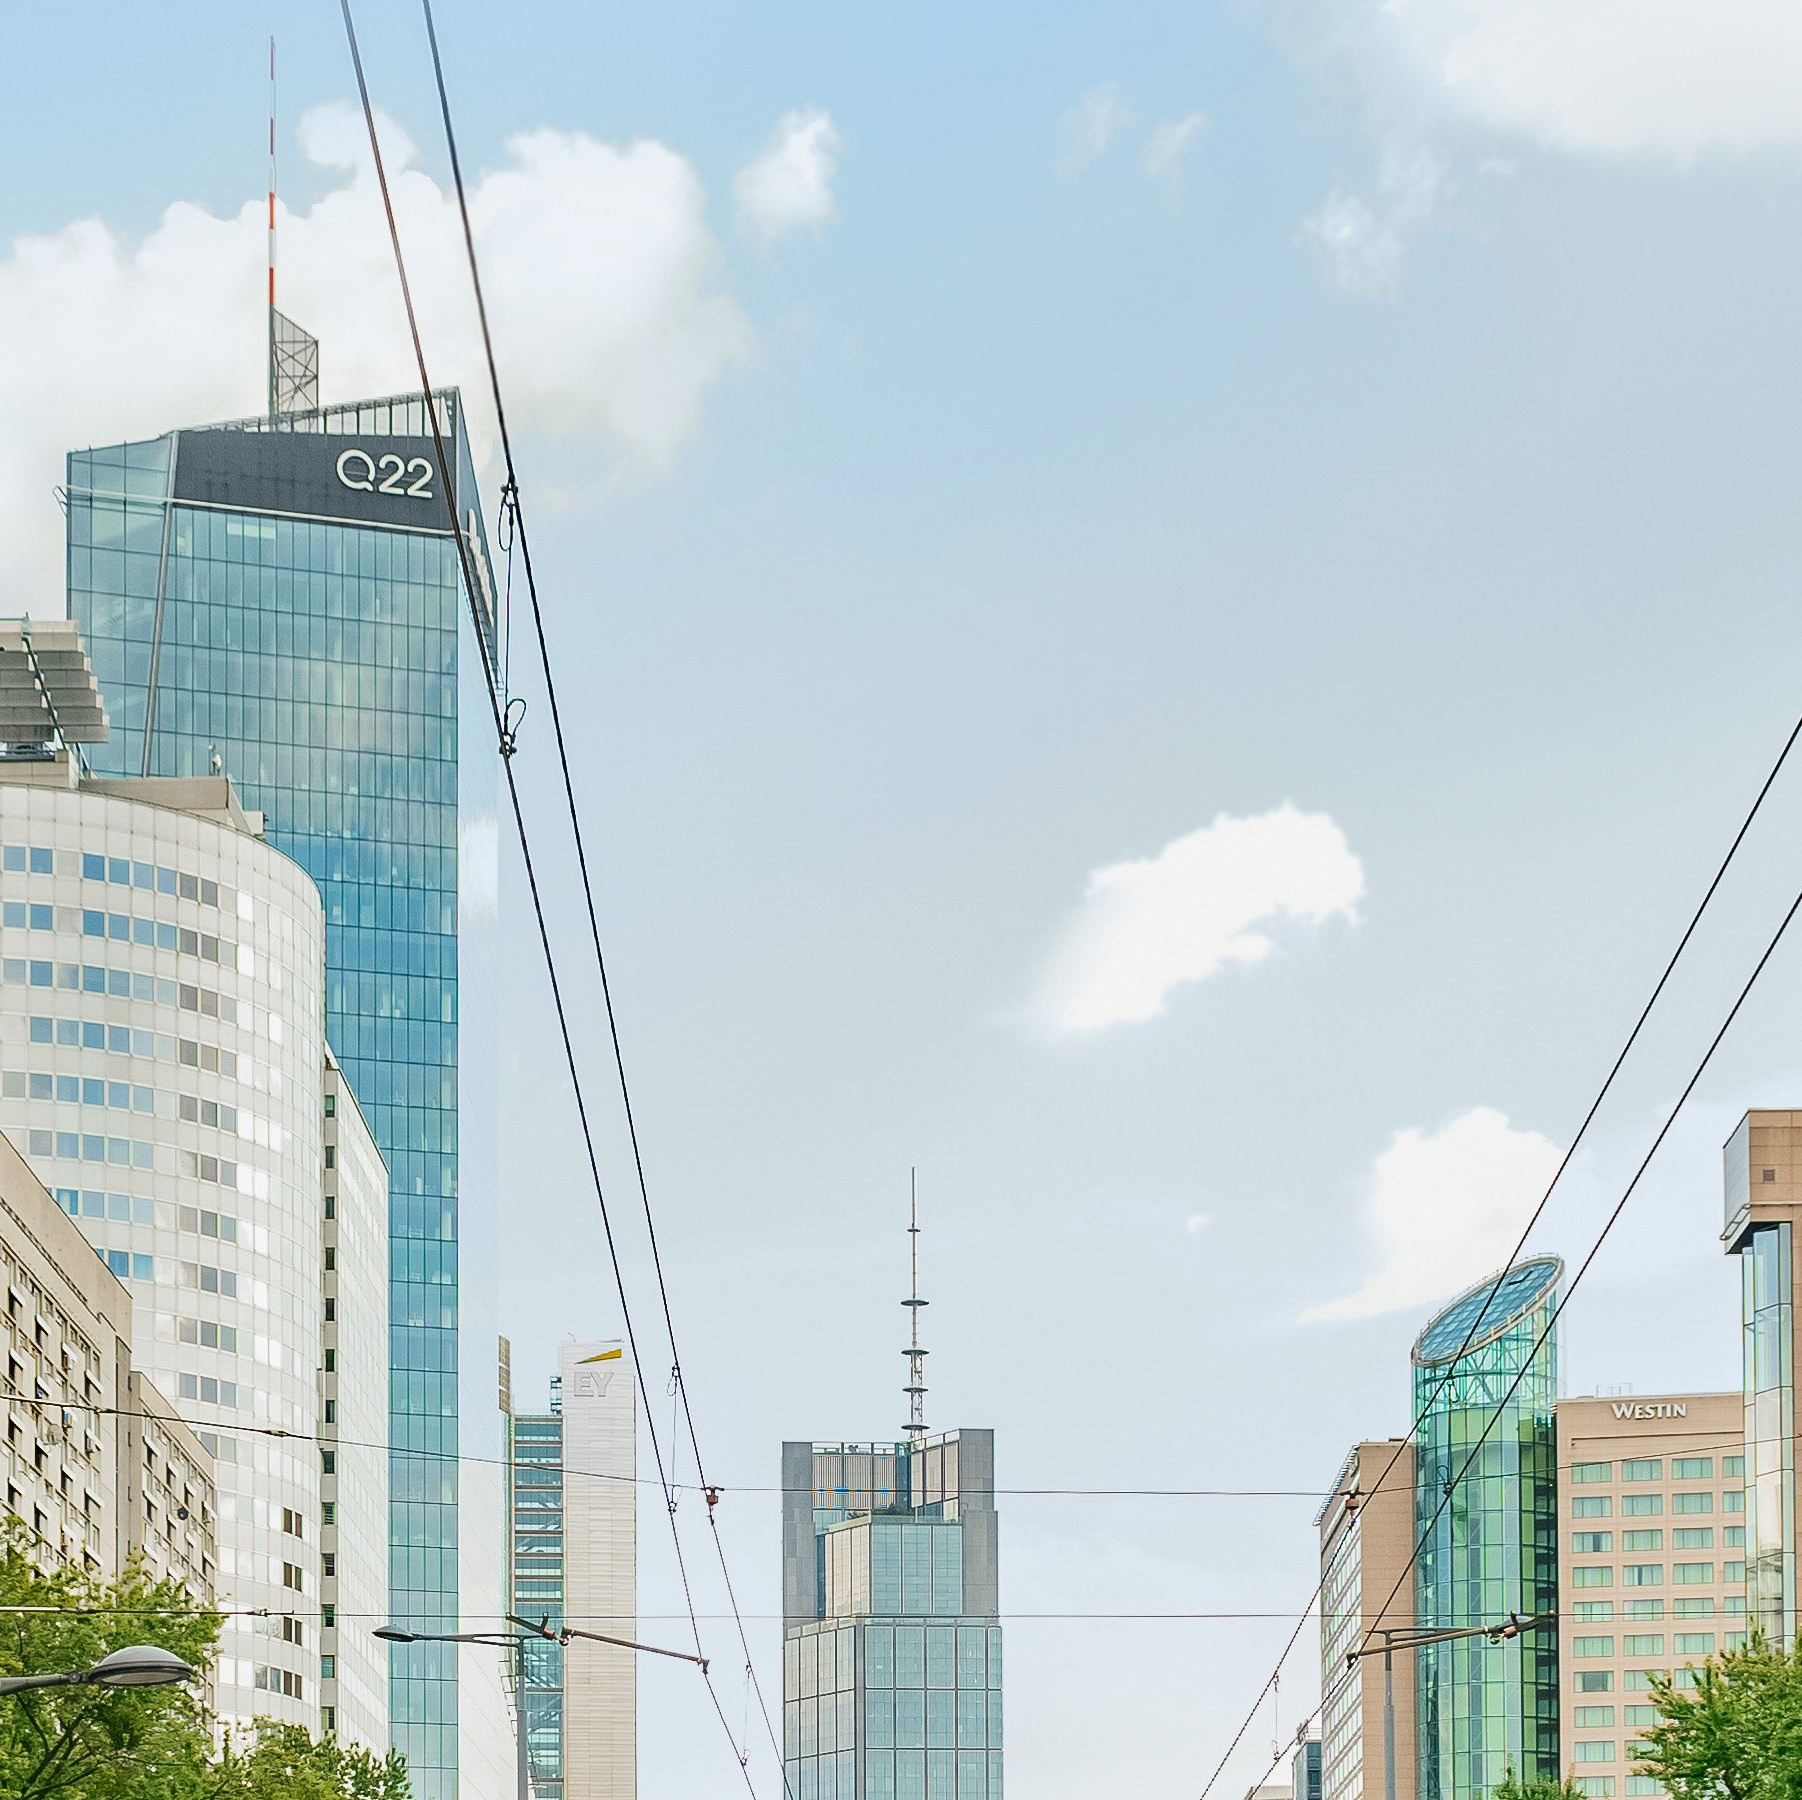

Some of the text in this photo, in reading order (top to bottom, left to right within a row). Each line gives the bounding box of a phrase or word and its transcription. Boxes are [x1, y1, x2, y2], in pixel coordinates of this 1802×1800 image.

[336, 449, 433, 499] Q22
[573, 1371, 615, 1397] EY
[1610, 1403, 1686, 1420] WESTIN
